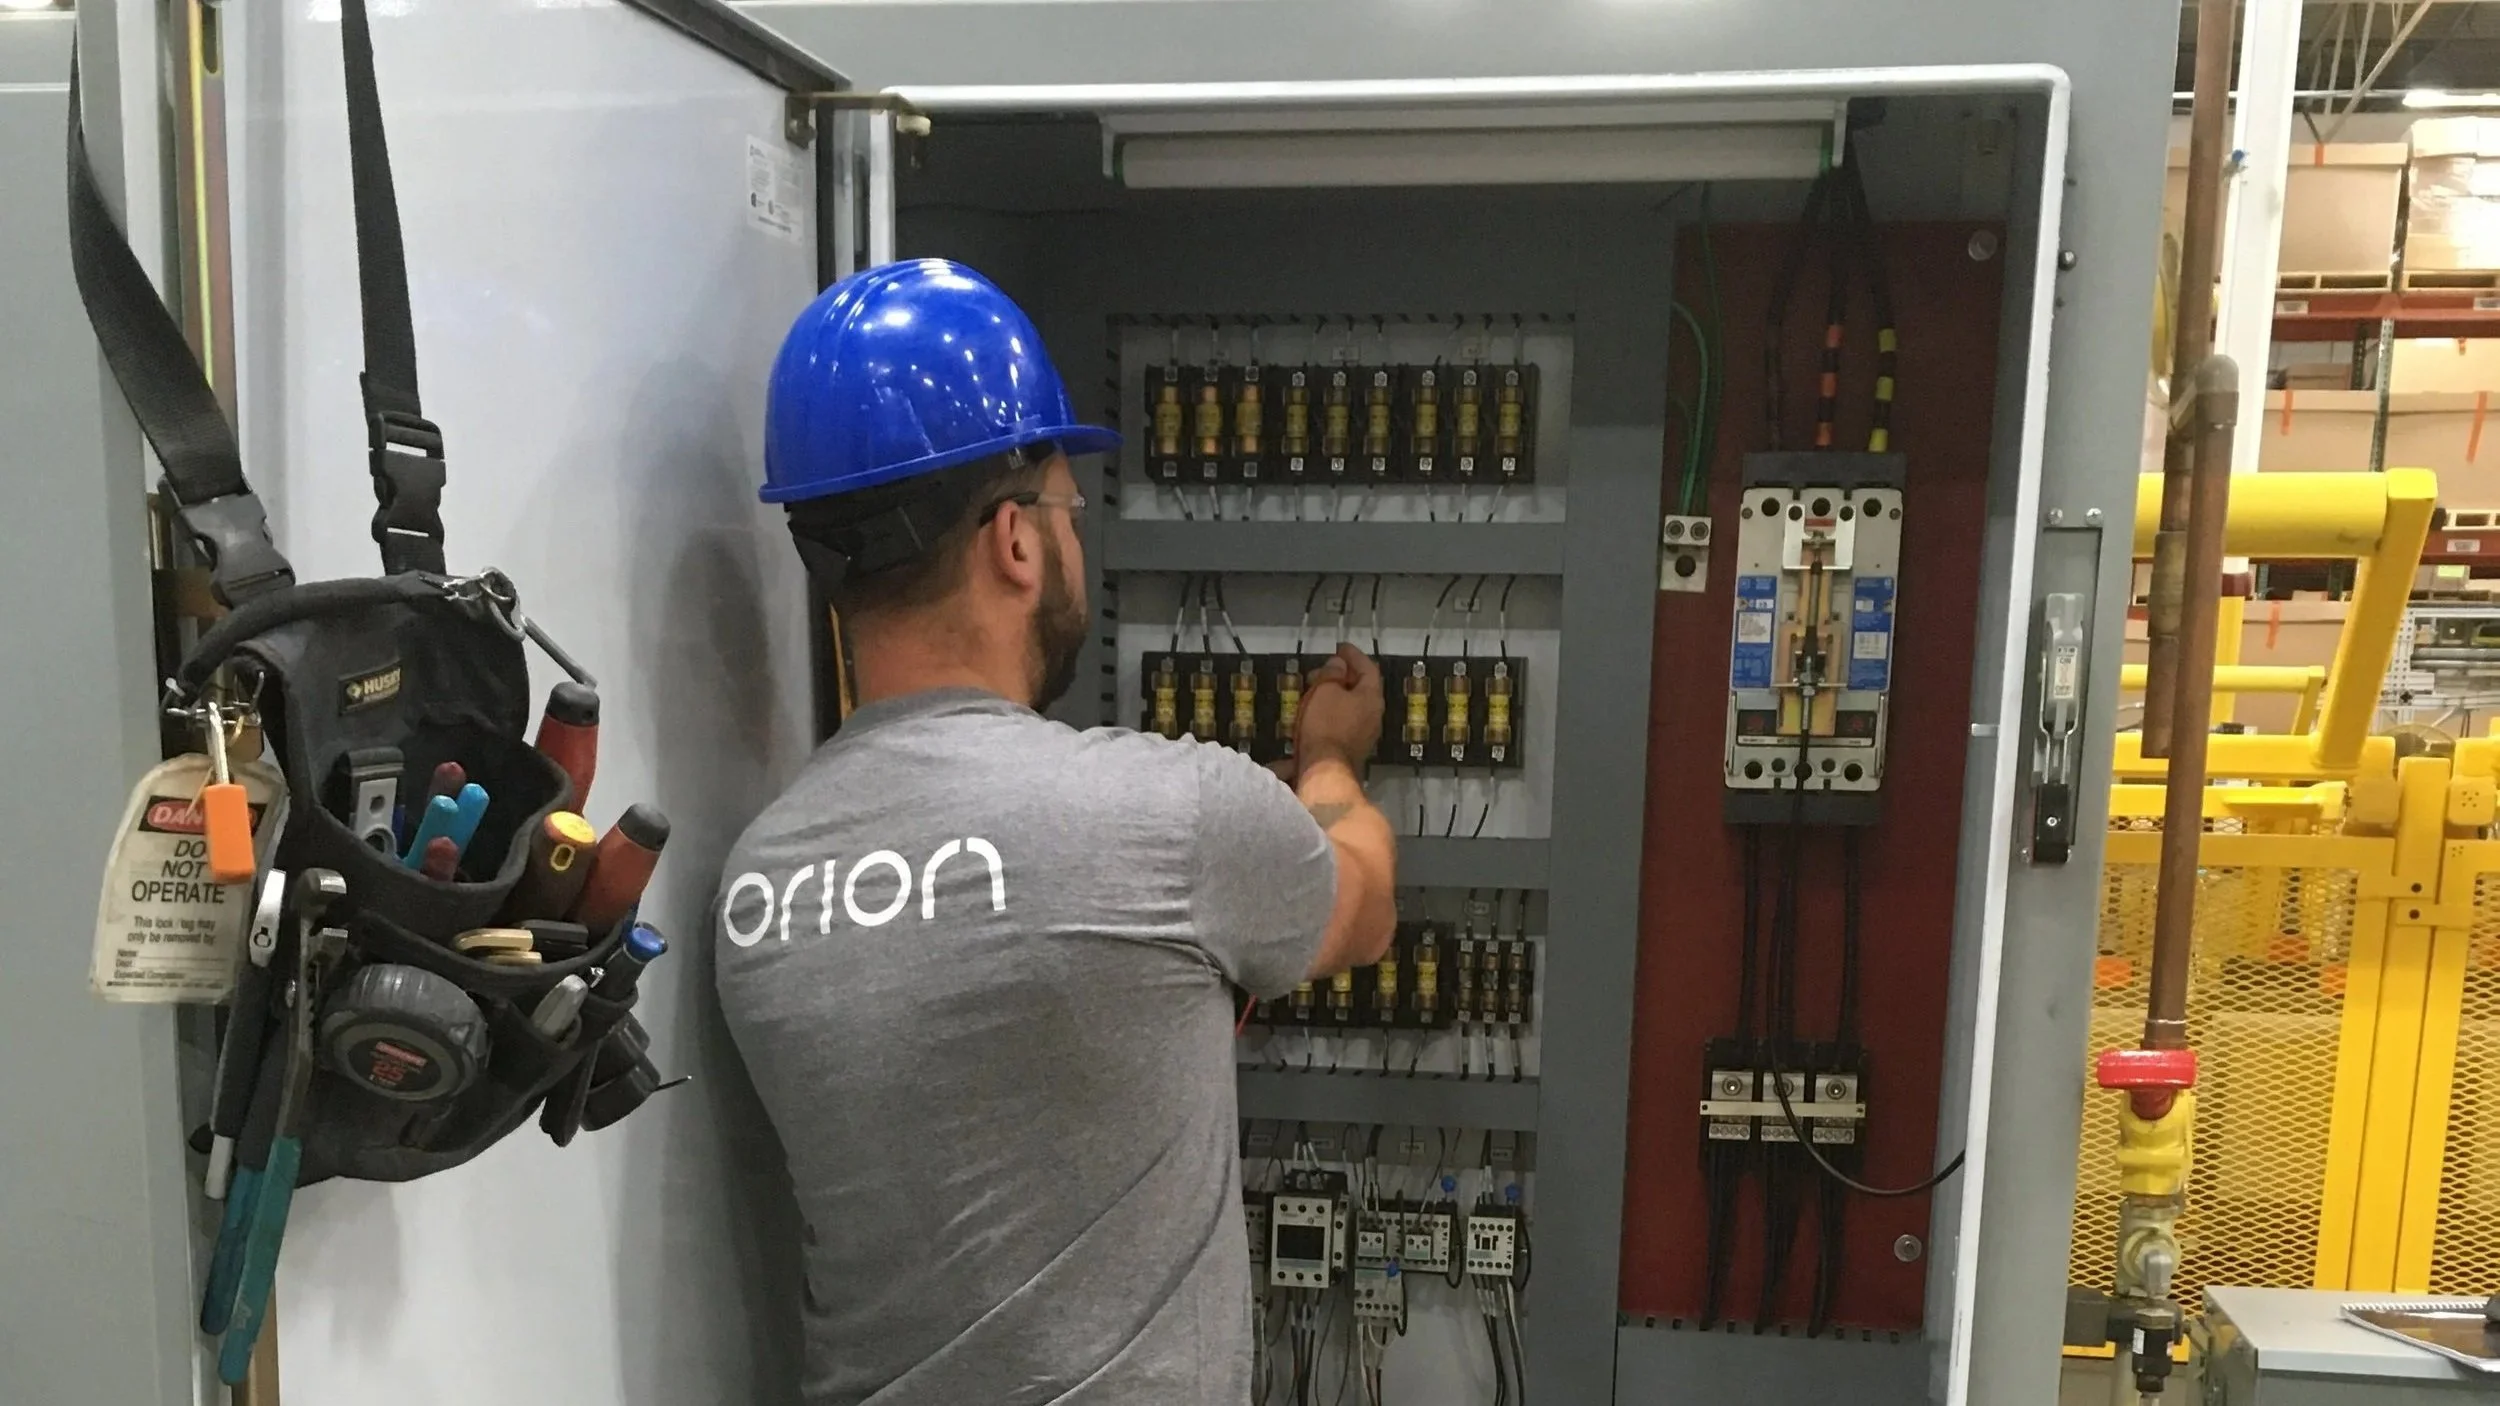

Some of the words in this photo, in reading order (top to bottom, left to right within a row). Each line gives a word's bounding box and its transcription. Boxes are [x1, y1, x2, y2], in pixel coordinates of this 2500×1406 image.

[153, 806, 204, 825] DAN
[174, 840, 206, 858] DO
[161, 860, 208, 878] NOT
[131, 880, 225, 904] OPERATE
[723, 836, 1007, 947] orion
[134, 915, 152, 929] This
[149, 932, 161, 943] be
